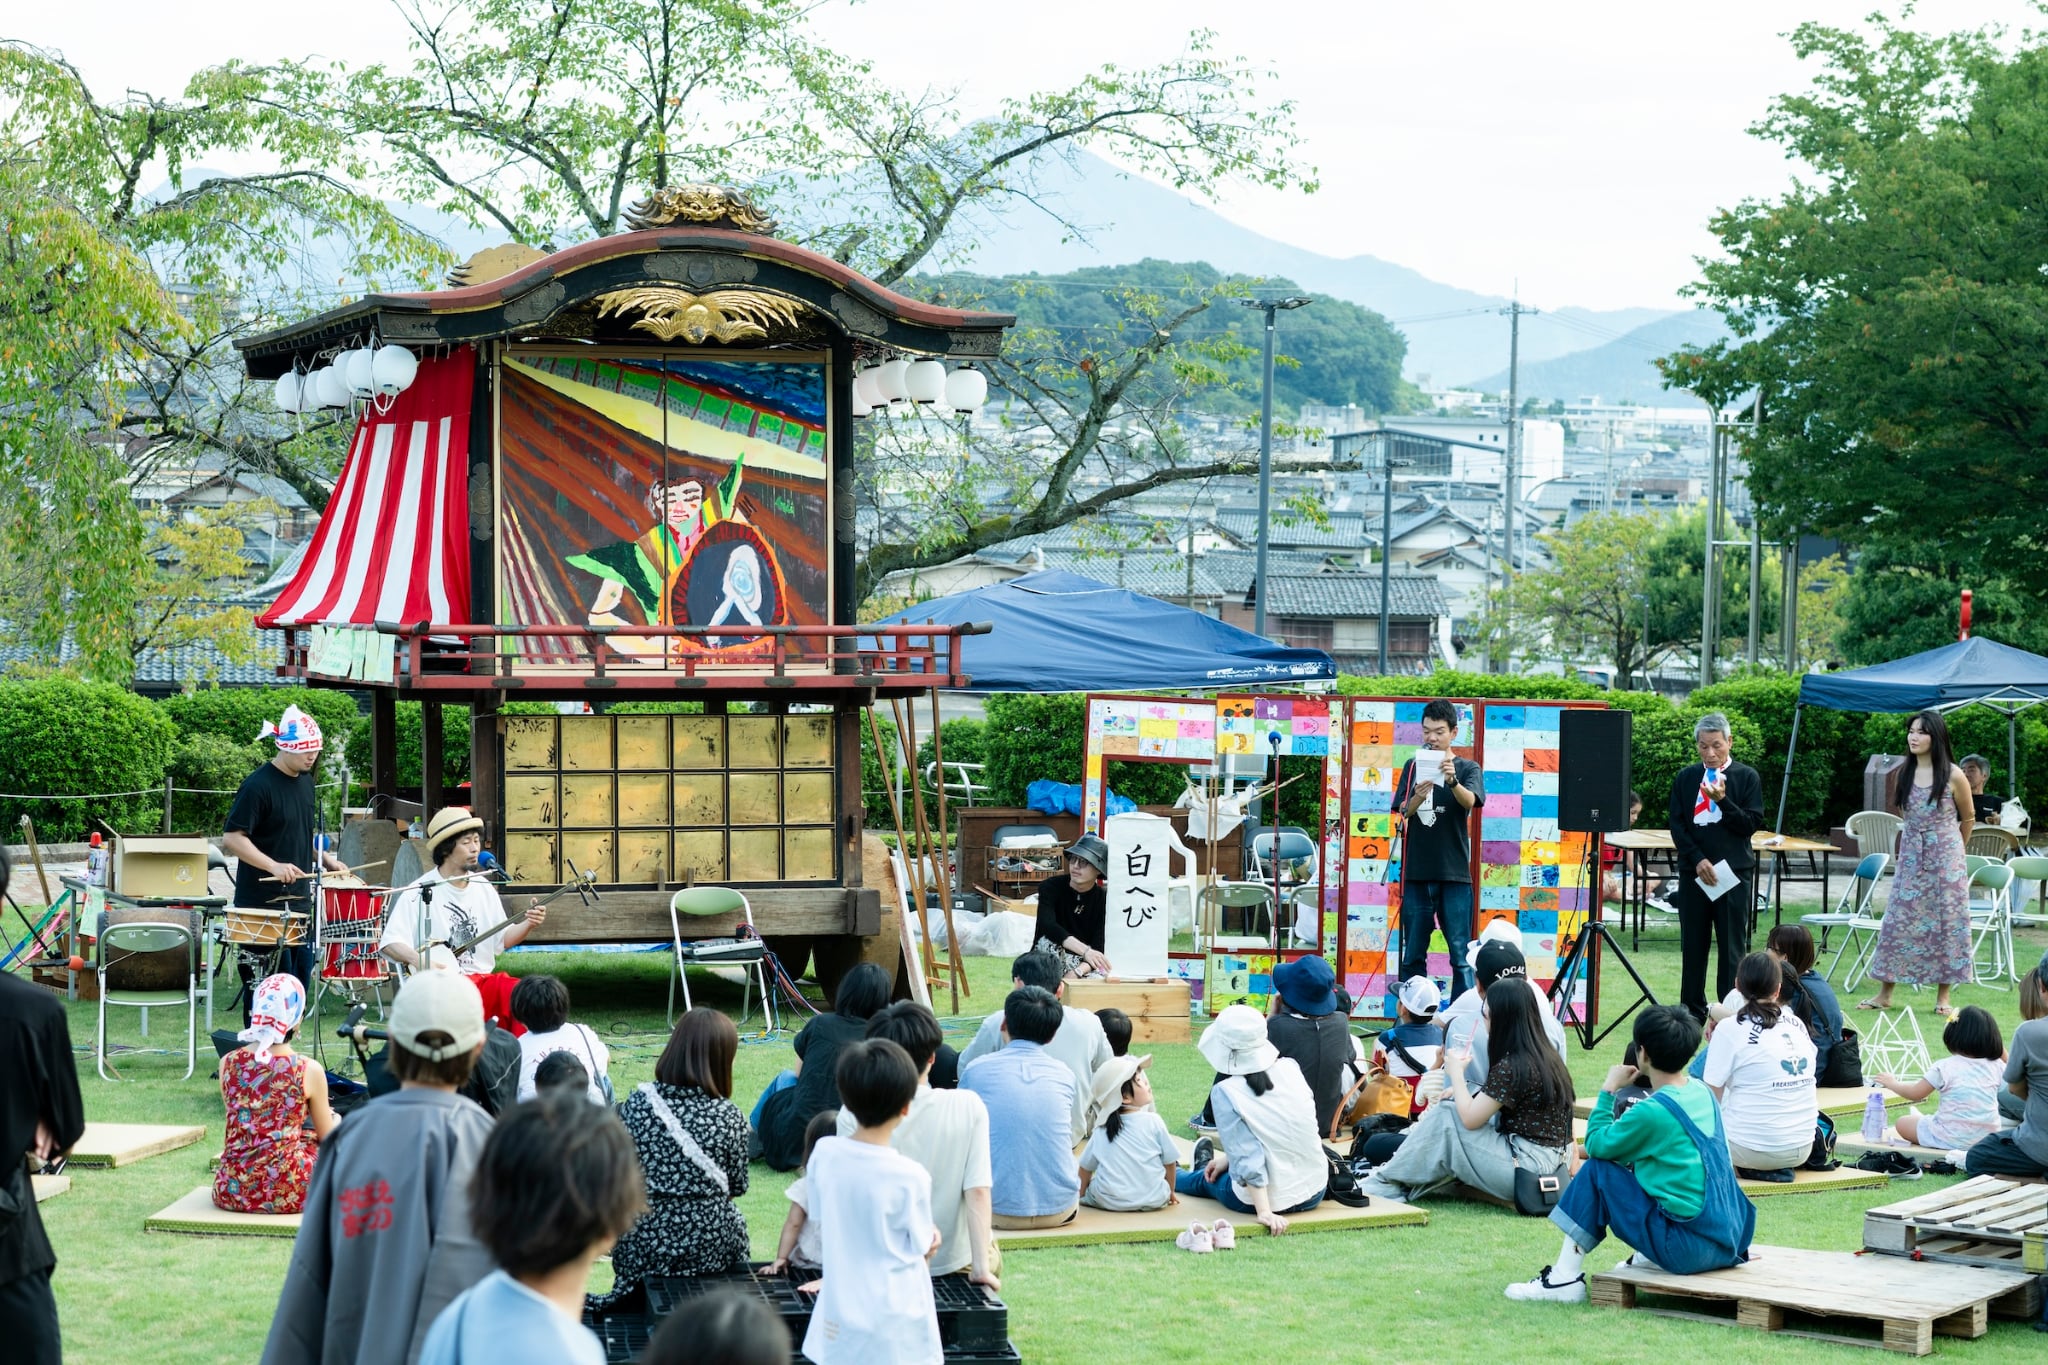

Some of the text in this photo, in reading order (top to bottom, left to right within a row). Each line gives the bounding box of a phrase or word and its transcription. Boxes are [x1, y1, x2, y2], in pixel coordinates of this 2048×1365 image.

[1122, 843, 1157, 928] 白へび
[1494, 965, 1526, 981] LOCAL
